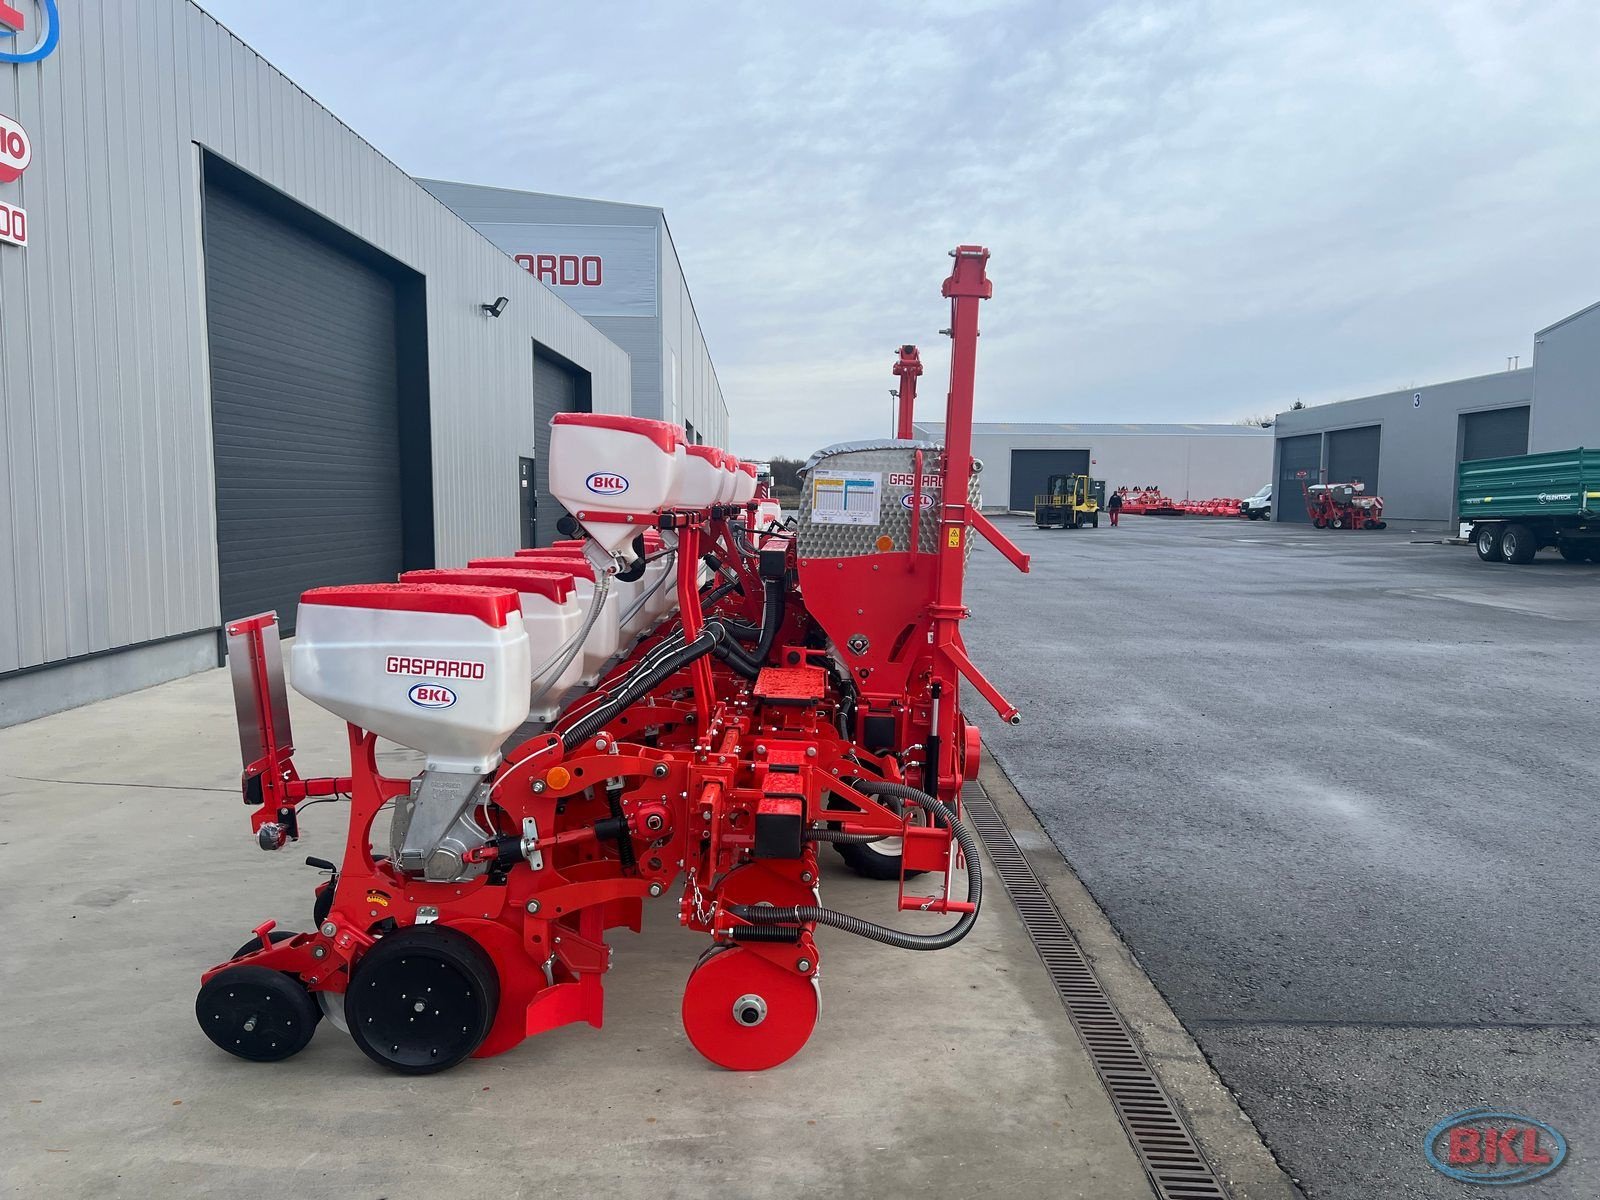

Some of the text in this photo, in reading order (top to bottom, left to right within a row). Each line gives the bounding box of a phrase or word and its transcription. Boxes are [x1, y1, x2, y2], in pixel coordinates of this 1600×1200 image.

[1414, 393, 1420, 407] 3
[594, 477, 623, 489] BKL
[387, 656, 484, 679] GASPARDO
[417, 688, 450, 702] BKL
